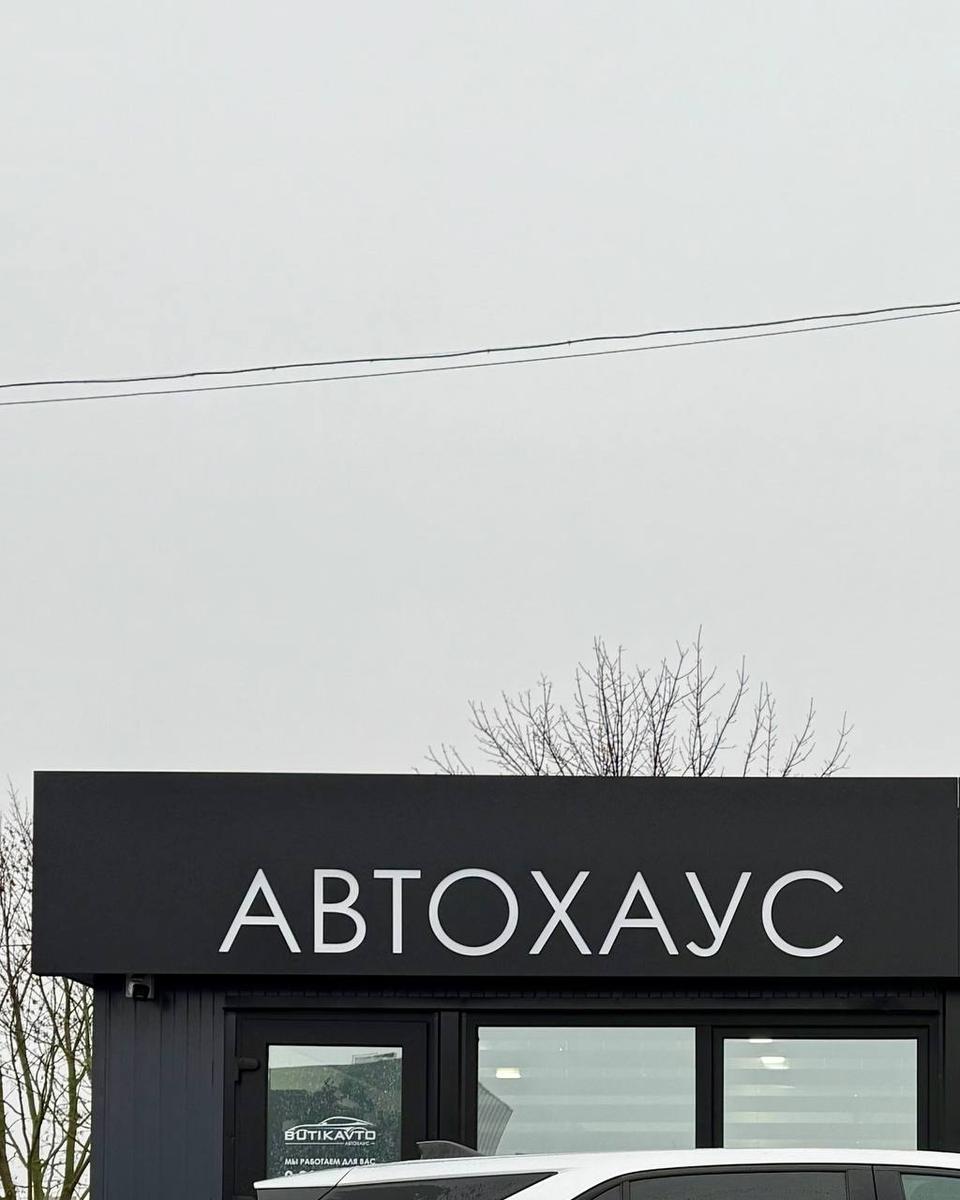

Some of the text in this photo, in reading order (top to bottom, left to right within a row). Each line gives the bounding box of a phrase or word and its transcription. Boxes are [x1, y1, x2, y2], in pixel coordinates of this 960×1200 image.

[217, 867, 845, 958] АВТОХАУС
[285, 1130, 376, 1140] BUTIKAVTO
[284, 1158, 376, 1166] МЫ РАБОТАЕМ ДЛЯ ВАС
